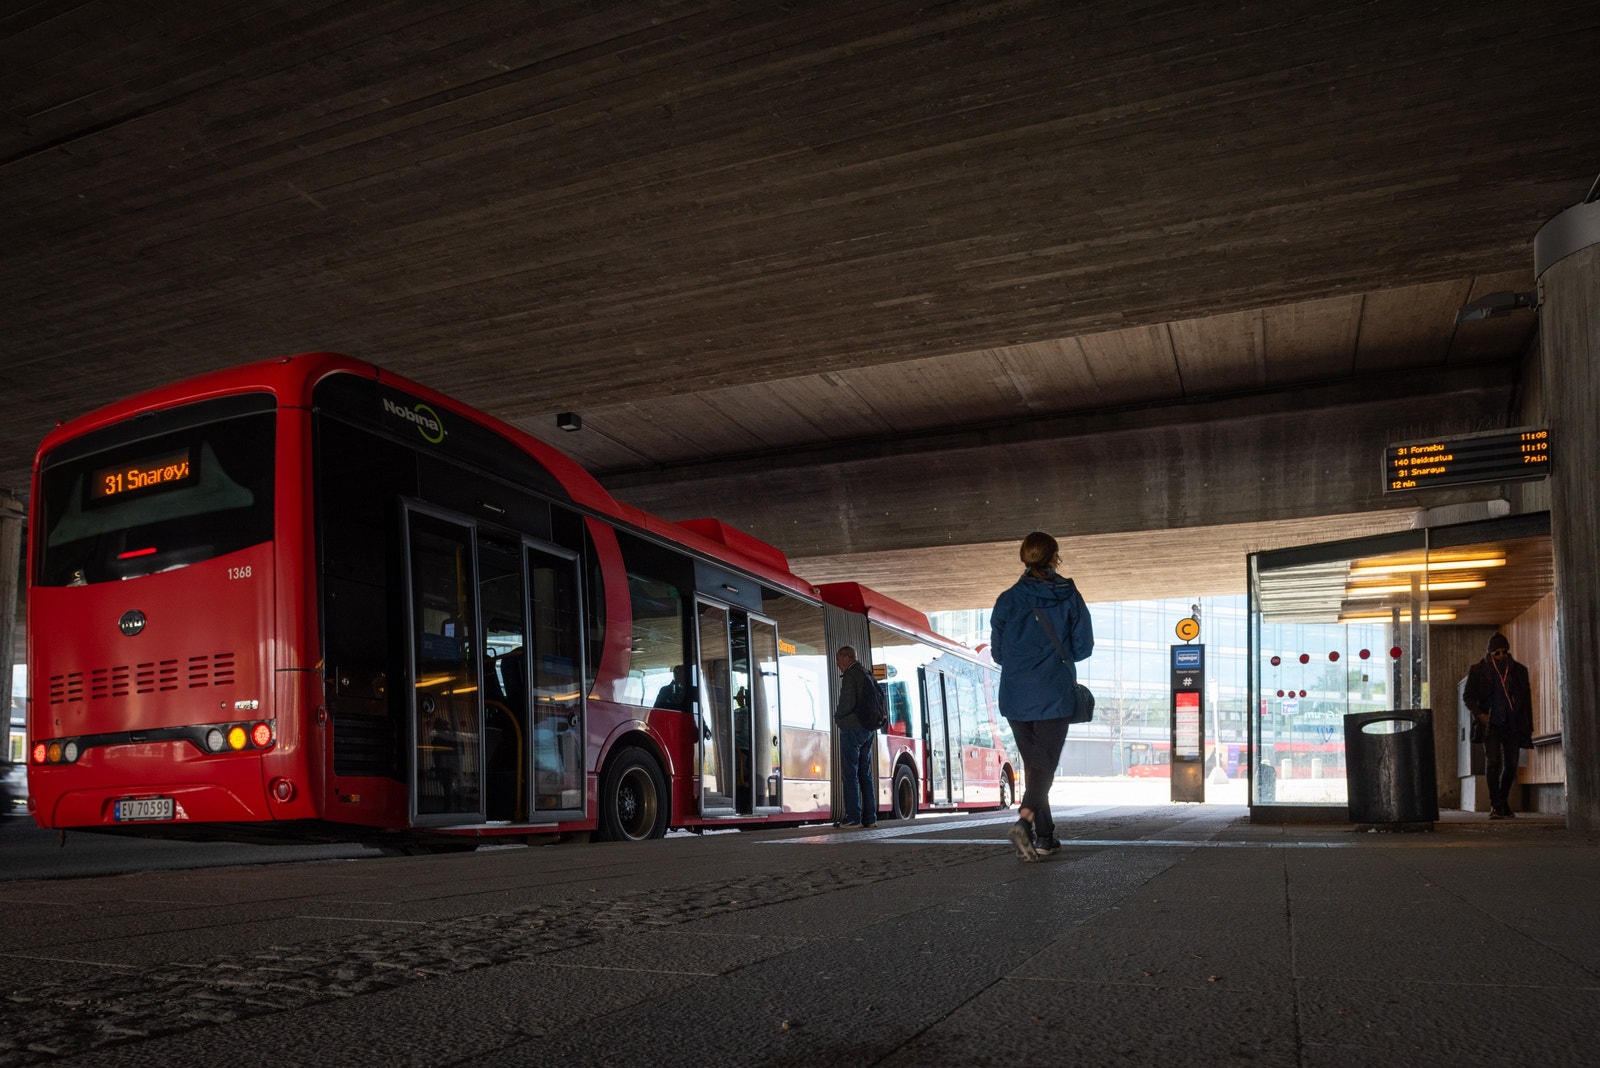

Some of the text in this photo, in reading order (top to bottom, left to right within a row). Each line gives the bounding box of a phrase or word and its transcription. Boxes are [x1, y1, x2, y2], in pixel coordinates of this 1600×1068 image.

[383, 398, 440, 432] Nobina
[1397, 443, 1445, 456] 31 Fornebu
[1521, 442, 1547, 452] 11:10
[1394, 454, 1453, 467] 140 Bekkestua
[1398, 469, 1408, 477] 31
[105, 473, 123, 495] 31
[1392, 480, 1416, 489] 12 min
[227, 565, 252, 580] 1368
[1181, 623, 1192, 636] C
[122, 800, 170, 817] EV 70599
